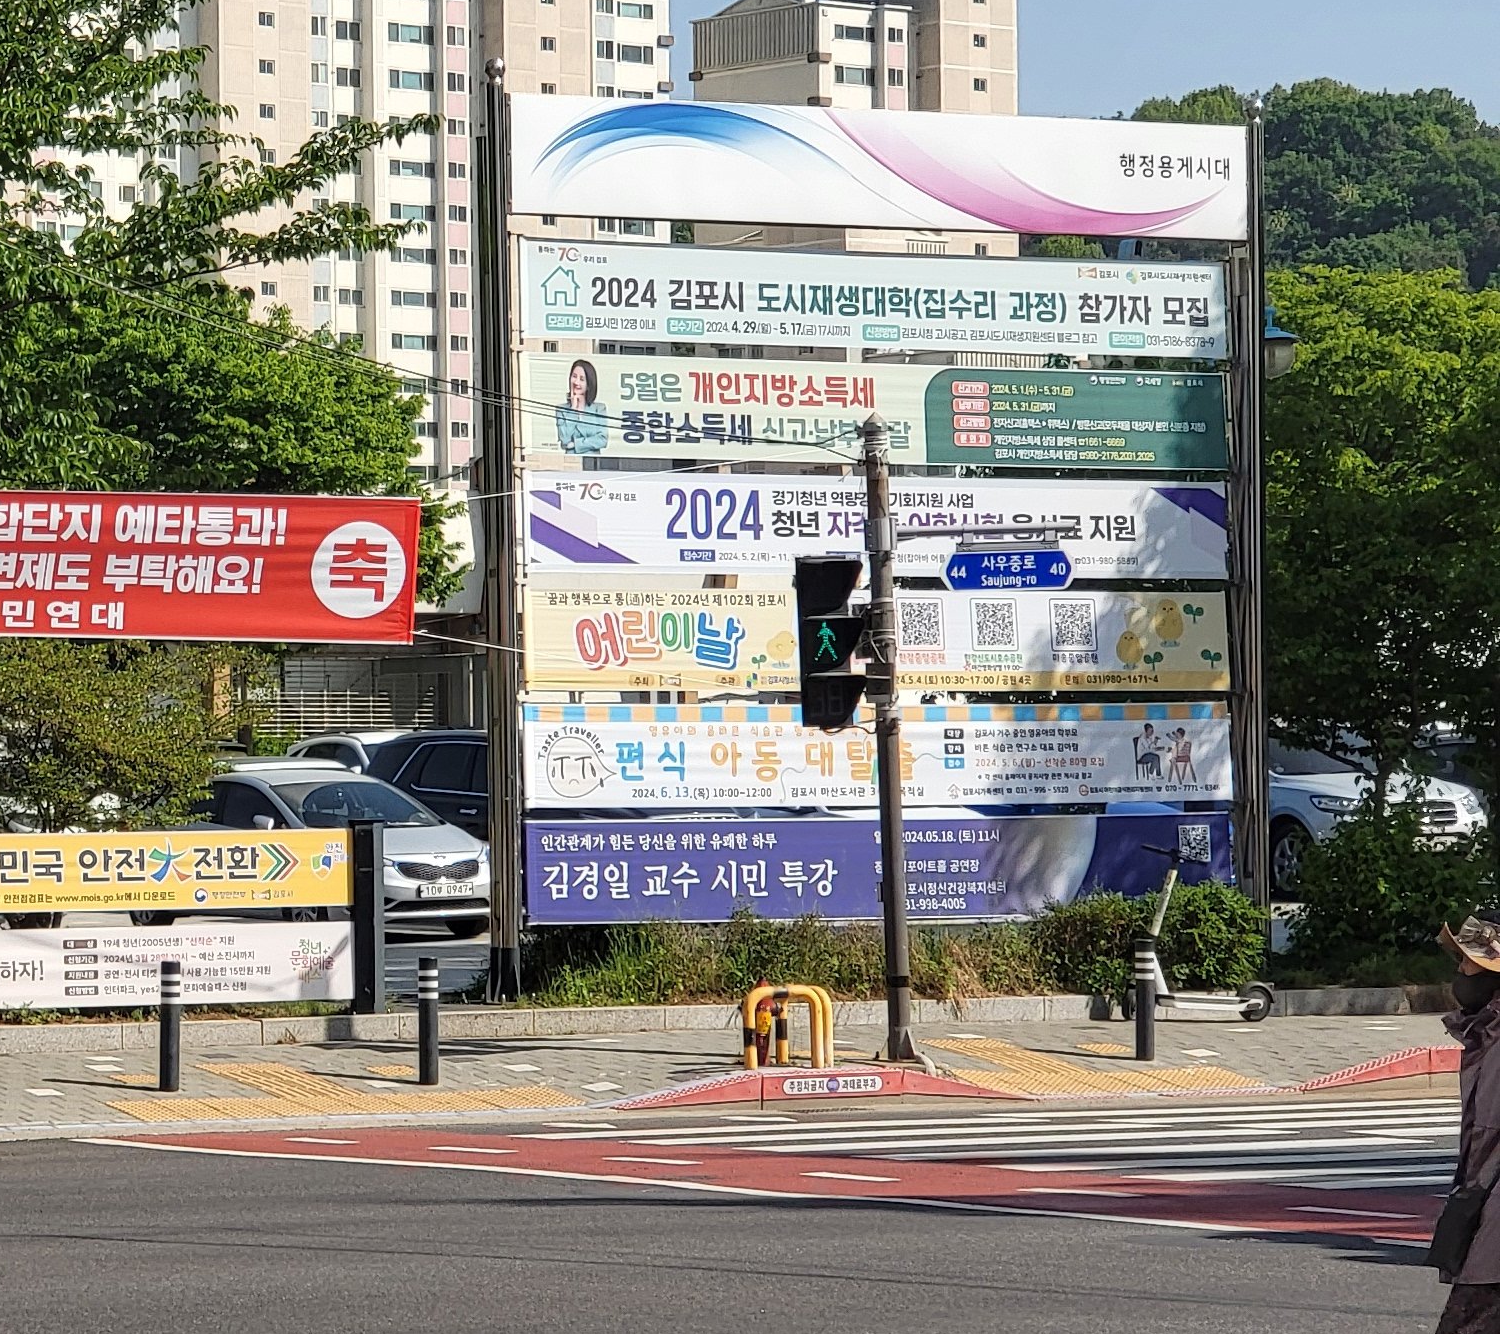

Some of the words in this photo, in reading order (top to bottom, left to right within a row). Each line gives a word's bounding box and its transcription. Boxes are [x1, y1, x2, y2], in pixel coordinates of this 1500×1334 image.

[1119, 153, 1230, 181] 행정용게시대
[591, 276, 657, 309] 2024
[667, 279, 745, 313] 김포시
[757, 282, 997, 322] 도시재생대학(집수리
[1009, 292, 1067, 324] 과정)
[1078, 293, 1151, 326] 참가자
[1162, 296, 1209, 327] 모집
[585, 317, 619, 329] 김포시민
[620, 318, 638, 331] 12명
[639, 318, 656, 331] 이내
[669, 321, 704, 333] 접수기간
[901, 328, 933, 340] 김포시청
[1081, 333, 1098, 344] 참고
[620, 372, 682, 403] 5월은
[689, 372, 876, 409] 개인지방소득세
[621, 410, 753, 446] 종합소득세
[763, 417, 858, 448] 신고·납부
[772, 490, 828, 507] 경기청년
[831, 491, 869, 508] 역량강
[889, 492, 943, 508] 기회지원
[947, 494, 974, 508] 사업
[665, 487, 764, 541] 2024
[114, 504, 287, 546] 예타통과!
[771, 510, 820, 538] 청년
[1090, 516, 1136, 542] 지원
[683, 550, 713, 561] 접수기간
[981, 555, 1036, 571] 사우중로
[102, 554, 264, 594] 부탁해요!
[328, 537, 388, 603] 축
[951, 566, 966, 579] 44
[1050, 563, 1066, 576] 40
[981, 574, 1037, 588] Saujung-ro
[571, 593, 612, 606] 행복으로
[671, 594, 710, 607] 2024년
[712, 594, 754, 607] 제102회
[757, 595, 787, 607] 김포시
[575, 610, 744, 670] 어린이날
[940, 676, 994, 685] 10:30~17:00
[538, 731, 559, 760] Taste
[561, 726, 604, 754] Traveller
[615, 741, 685, 783] 편식
[710, 741, 782, 783] 아동
[713, 787, 772, 799] 10:00~12:00
[790, 787, 817, 799] 김포시
[821, 787, 866, 799] 마산도서관
[541, 834, 605, 852] 인간관계가
[609, 834, 635, 851] 힘든
[639, 834, 676, 851] 당신을
[680, 834, 706, 851] 위한
[710, 833, 748, 850] 유쾌한
[751, 832, 778, 850] 하루
[959, 830, 975, 845] (토)
[978, 829, 1000, 843] 11시
[904, 860, 947, 873] 포아트홀
[950, 859, 980, 873] 공연장
[542, 861, 630, 900] 김경일
[642, 861, 700, 899] 교수
[711, 860, 770, 898] 시민
[778, 859, 838, 898] 특강
[904, 882, 1007, 895] 포시정신건강복지센터
[3, 893, 53, 904] 안전점검표는
[55, 891, 141, 904] www.mois.go.kr에서
[143, 891, 176, 902] 다운로드
[905, 898, 966, 910] 31-998-4005
[102, 939, 120, 948] 19세
[218, 936, 235, 945] 지원
[299, 939, 322, 955] 청년
[104, 954, 133, 963] 2024년
[199, 953, 215, 961] 예산
[216, 951, 255, 961] 소진시까지
[186, 967, 202, 977] 사용
[204, 967, 227, 977] 가능한
[255, 965, 271, 975] 지원
[104, 985, 138, 995] 인터파크,
[789, 1080, 825, 1092] 주정차금지
[841, 1078, 877, 1089] 과태료부과
